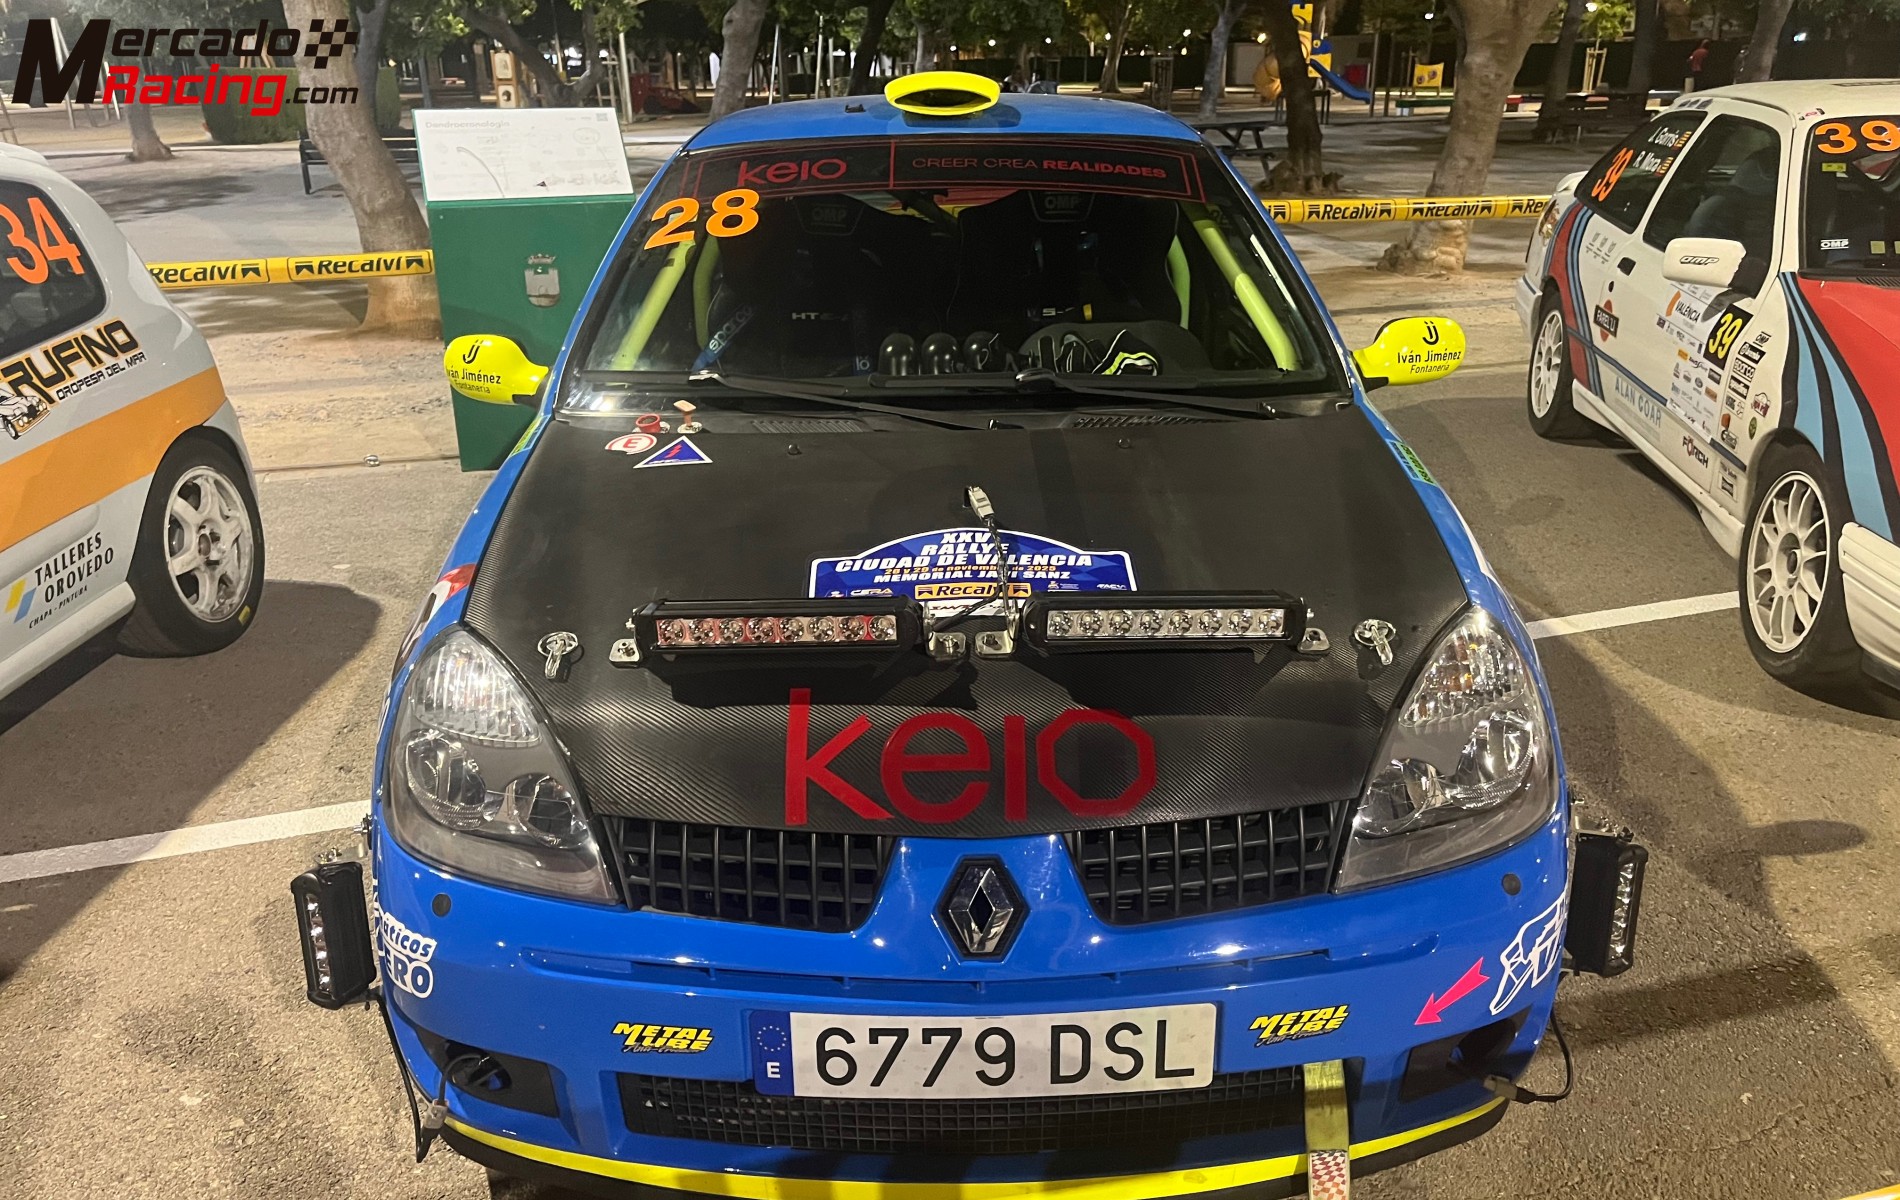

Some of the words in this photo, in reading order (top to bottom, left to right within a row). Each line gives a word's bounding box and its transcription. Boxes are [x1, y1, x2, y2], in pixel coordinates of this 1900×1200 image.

[1814, 120, 1900, 154] 39
[912, 158, 977, 168] CREER
[983, 158, 1038, 168] CREA
[1042, 160, 1167, 178] REALIDADES
[1591, 147, 1634, 202] 39
[644, 188, 759, 250] 28
[1321, 203, 1378, 220] Recalvi
[1423, 202, 1480, 218] Recalvi
[0, 197, 85, 284] 34
[1820, 240, 1850, 249] OMP
[317, 256, 403, 275] Recalvi
[708, 304, 754, 352] sparco
[1708, 312, 1743, 360] 39
[1, 319, 140, 405] RUFINO
[1397, 350, 1421, 364] Iván
[1424, 348, 1461, 362] Jiménez
[55, 370, 106, 400] OROPESA
[104, 362, 125, 377] DEL
[124, 352, 147, 368] MAR
[461, 369, 501, 385] Jiménez
[622, 437, 642, 449] E
[941, 532, 991, 544] XXV
[34, 532, 102, 587] TALLERES
[920, 543, 1010, 556] RALLYE
[835, 556, 931, 573] CIUDAD
[937, 554, 968, 566] DE
[44, 547, 114, 603] OROVEDO
[873, 571, 973, 583] MEMORIAL
[1022, 571, 1071, 579] SANZ
[936, 585, 1002, 596] Recal
[29, 609, 52, 629] CHAPA
[59, 585, 87, 609] PINTURA
[1249, 1004, 1349, 1039] METAL
[612, 1022, 714, 1046] METAL
[815, 1026, 1016, 1088] 6779
[1050, 1019, 1196, 1086] DSL
[766, 1062, 780, 1079] E
